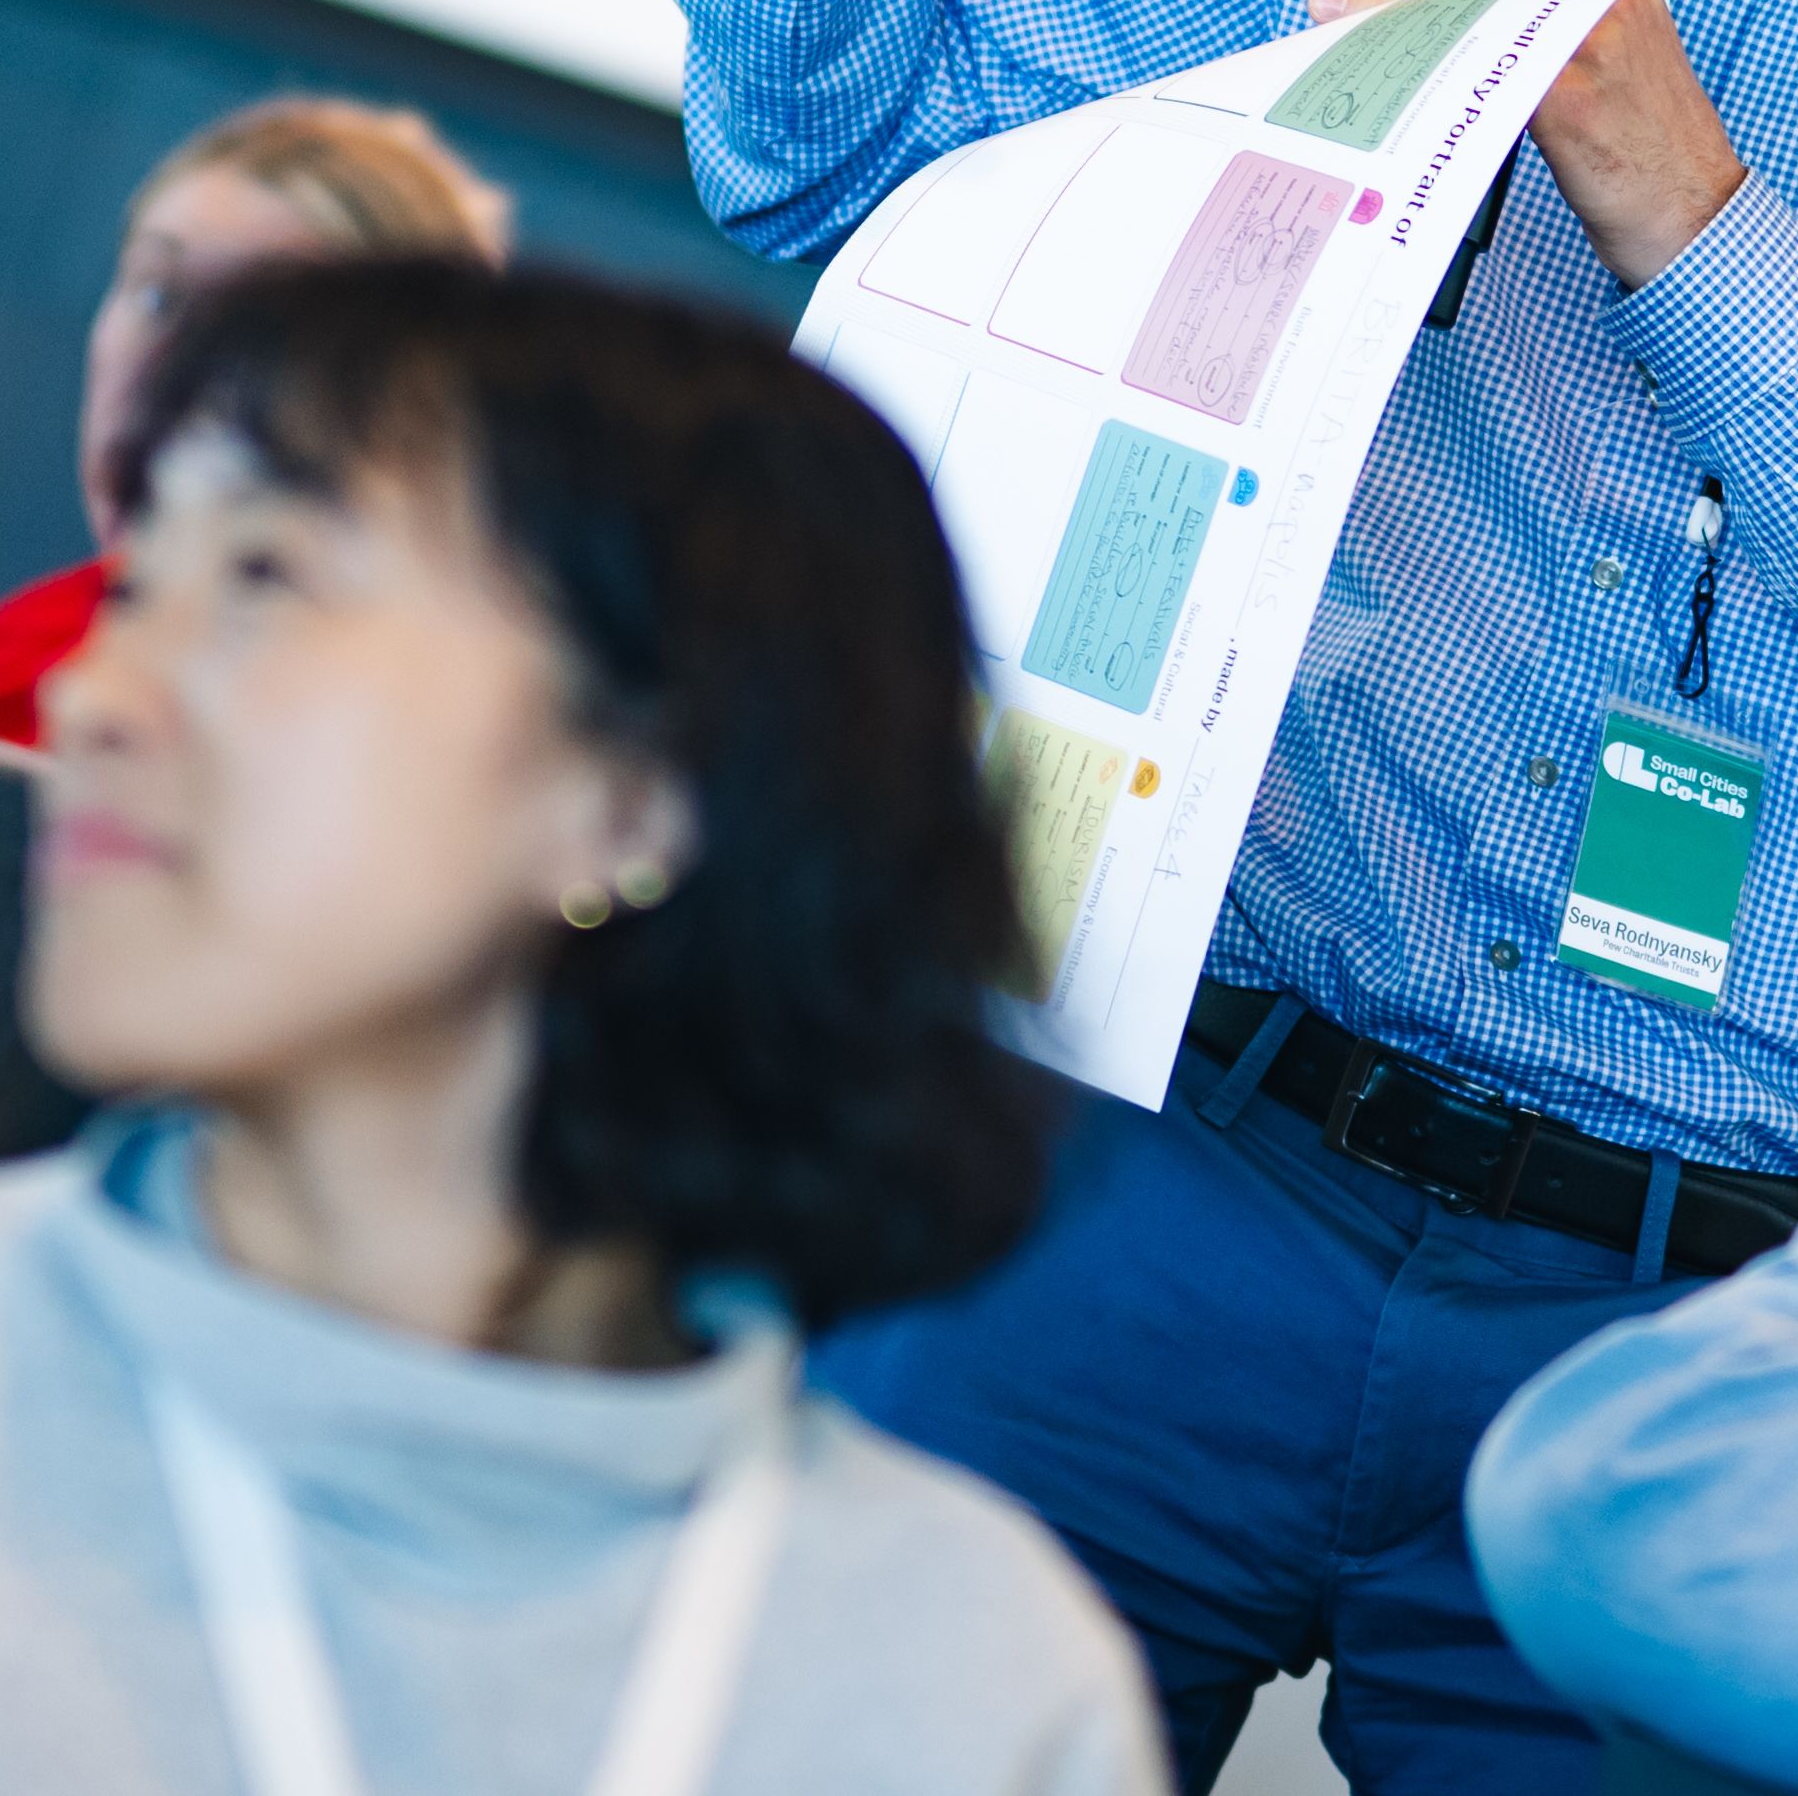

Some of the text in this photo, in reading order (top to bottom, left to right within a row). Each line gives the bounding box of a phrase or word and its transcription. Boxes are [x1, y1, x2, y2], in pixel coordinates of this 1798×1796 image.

[1472, 53, 1518, 102] City
[1386, 80, 1441, 155] Environment
[1406, 104, 1480, 209] Portrait
[1390, 217, 1412, 248] of
[1252, 341, 1296, 429] Environment
[1176, 508, 1204, 552] Arts
[1142, 575, 1182, 661] Festivals
[1151, 601, 1201, 722] Social & Cultural
[1210, 647, 1240, 705] made
[1199, 707, 1221, 734] by
[1650, 755, 1748, 799] Small Cities
[1660, 776, 1746, 819] Co-Lab
[1057, 799, 1107, 904] TOURISM
[1153, 854, 1182, 880] 4
[1053, 846, 1118, 1012] Economy & Institutions
[1568, 906, 1722, 973] Seva Rodnyansky
[1603, 938, 1700, 978] Pew Charitable Trusts
